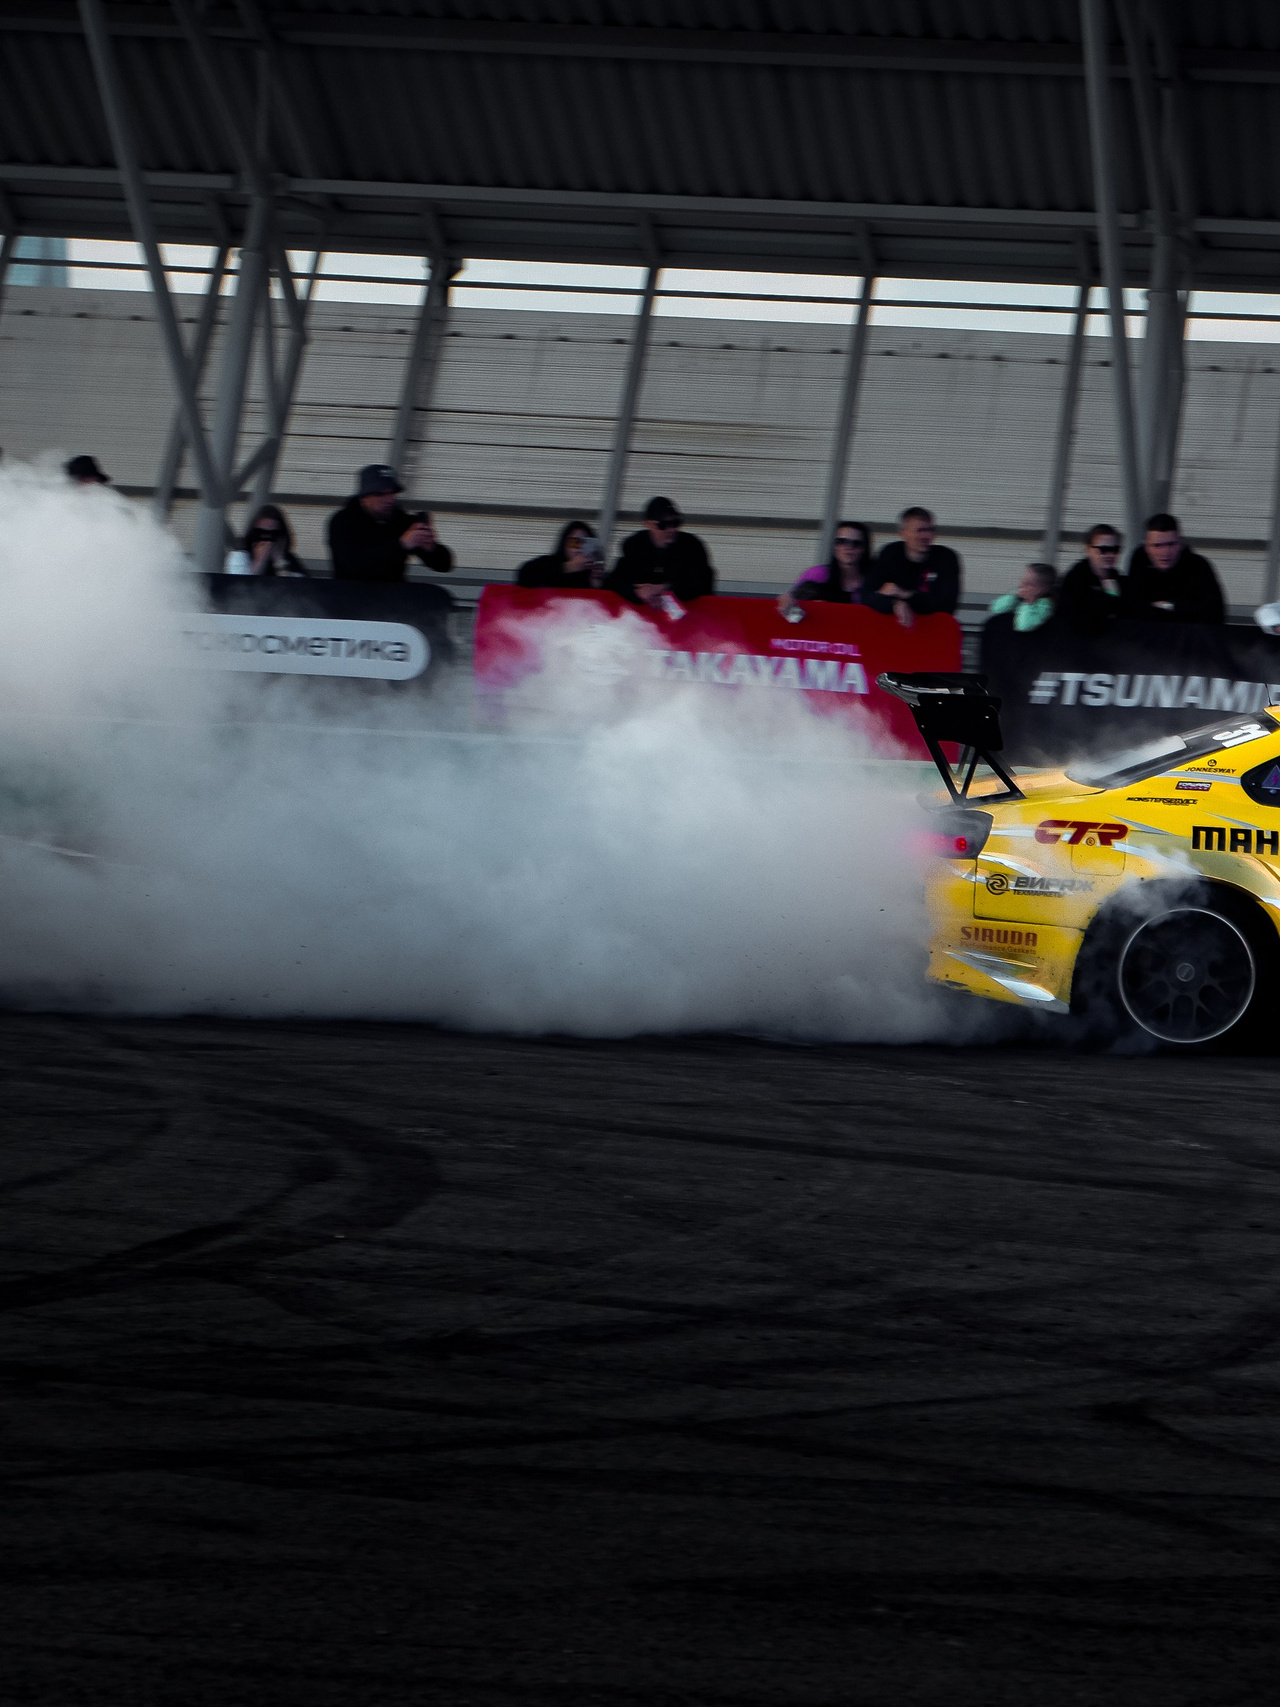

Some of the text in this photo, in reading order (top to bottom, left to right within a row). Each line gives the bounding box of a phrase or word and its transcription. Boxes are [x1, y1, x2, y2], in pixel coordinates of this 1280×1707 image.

[650, 649, 869, 694] TAKAYAMA
[1185, 767, 1237, 775] JONNESWAY
[1035, 819, 1129, 846] CTR
